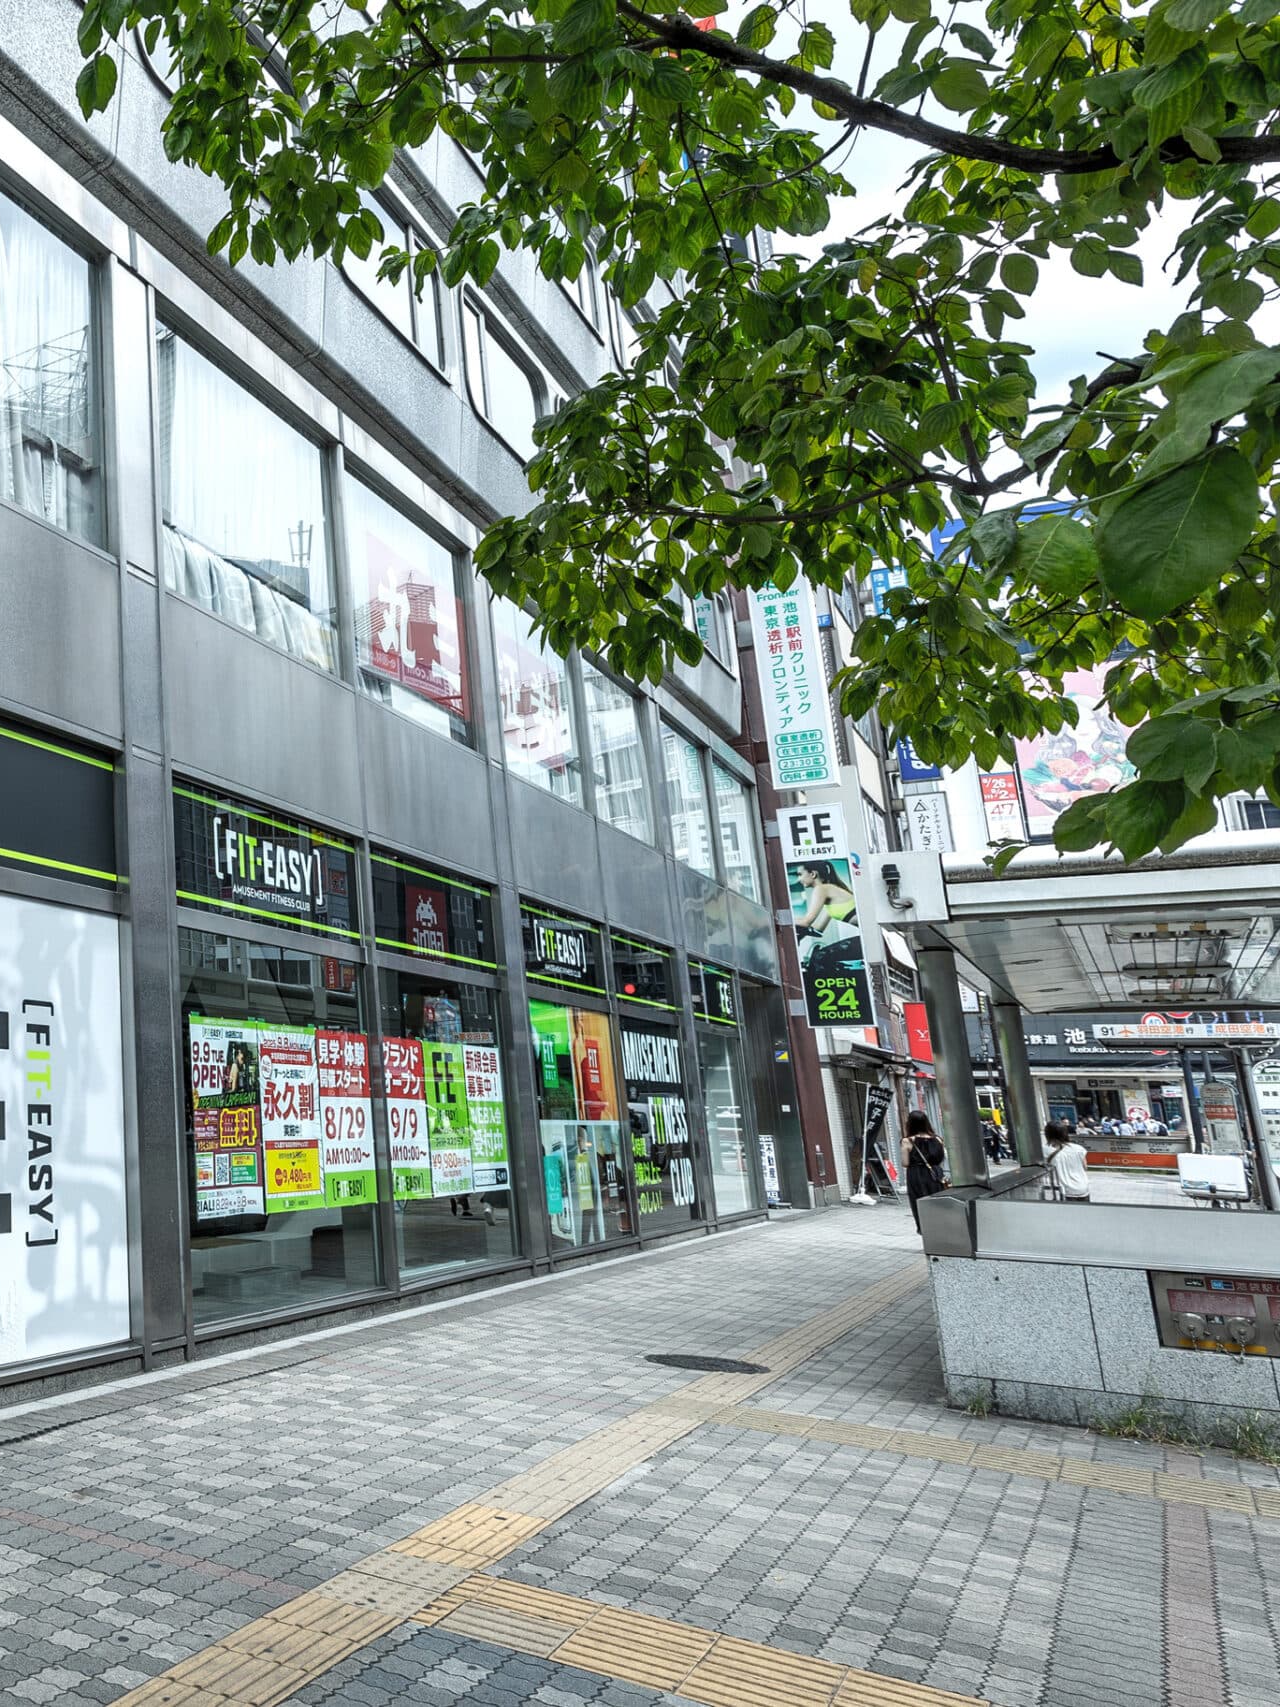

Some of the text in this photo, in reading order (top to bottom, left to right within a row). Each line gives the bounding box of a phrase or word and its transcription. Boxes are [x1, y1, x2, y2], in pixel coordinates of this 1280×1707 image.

[763, 604, 794, 729] 東京透析フロンティア
[782, 601, 812, 715] 池袋駅前クリニック
[232, 884, 310, 912] AMUSEMENT FITNESS CLUB
[814, 977, 857, 988] OPEN
[816, 988, 859, 1011] 24
[819, 1010, 862, 1020] HOURS
[1101, 1027, 1115, 1036] 91
[465, 1050, 498, 1074] 新規会員
[542, 1041, 554, 1063] FIT
[587, 1048, 598, 1069] FIT
[384, 1070, 421, 1096] オープン
[263, 1081, 315, 1121] 永久割
[221, 1108, 257, 1147] 無料
[324, 1105, 366, 1141] 8/29
[390, 1107, 418, 1141] 9/9
[648, 1096, 689, 1146] FITNESS
[606, 1160, 616, 1182] FIT
[670, 1158, 696, 1207] CLUB
